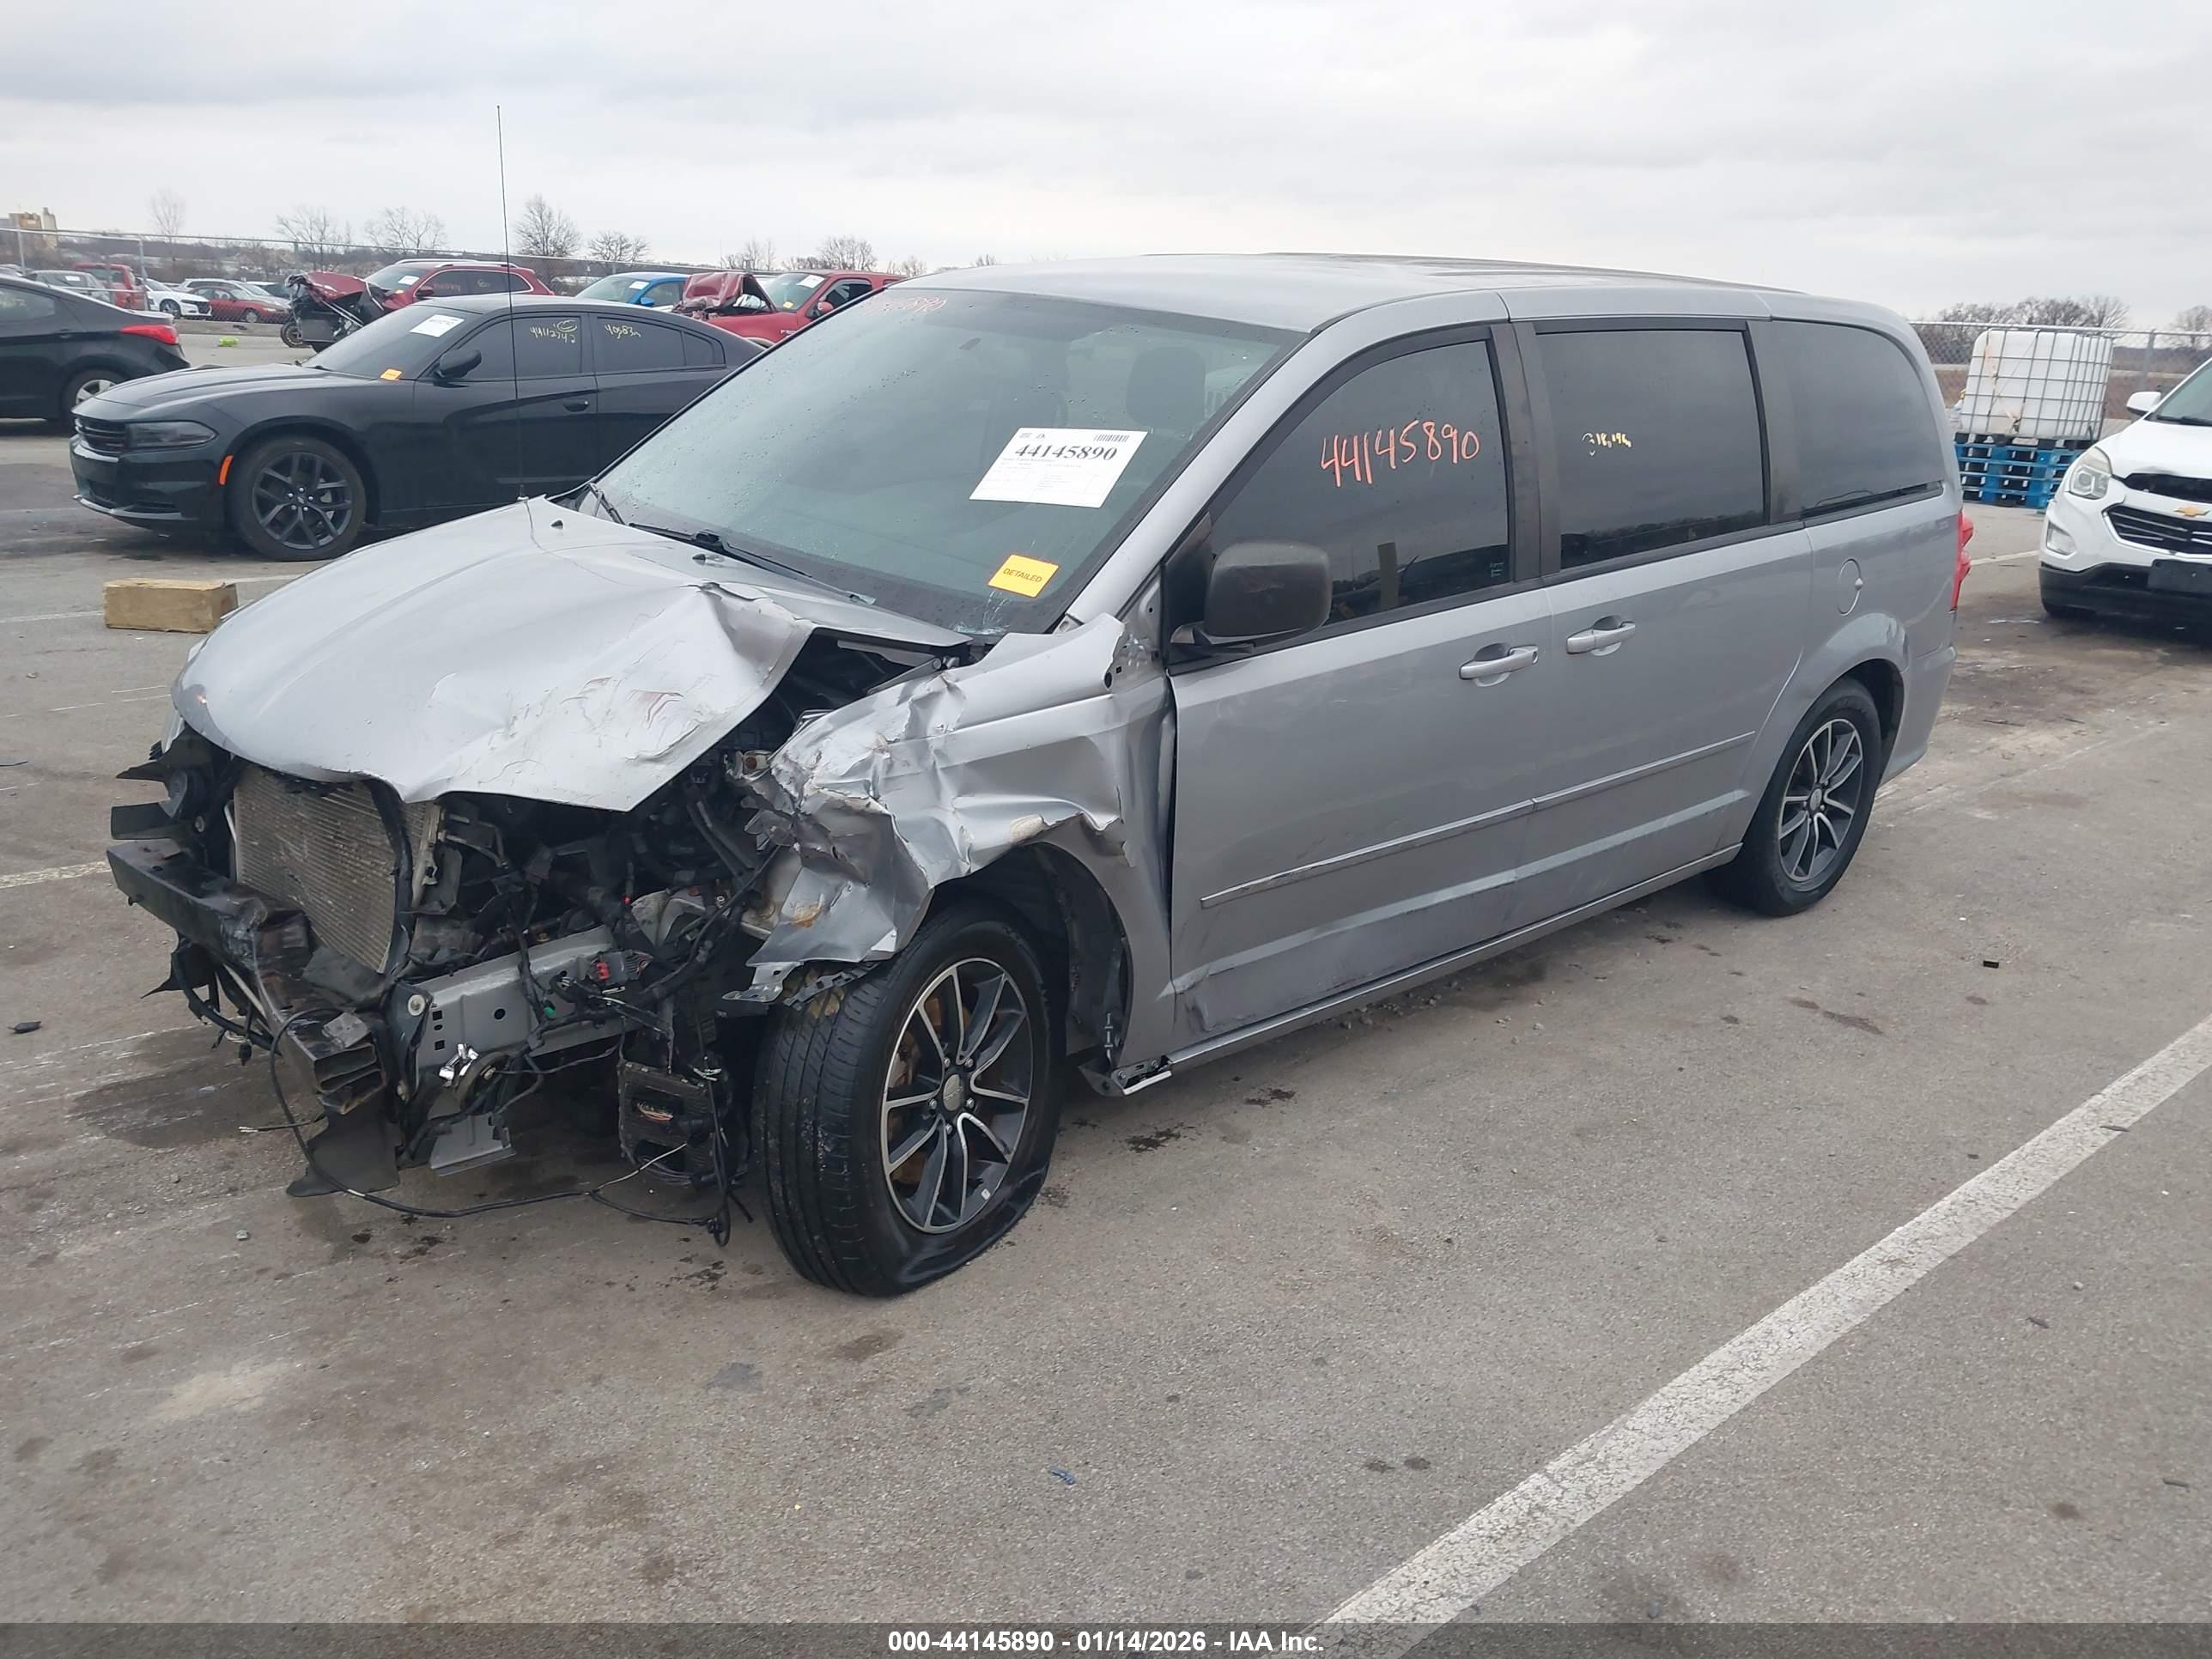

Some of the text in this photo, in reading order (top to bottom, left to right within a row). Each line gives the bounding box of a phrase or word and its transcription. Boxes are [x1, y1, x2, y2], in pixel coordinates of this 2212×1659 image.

[1014, 443, 1118, 461] 44145890
[1320, 419, 1480, 488] 44145890
[1002, 567, 1043, 583] DETAILED
